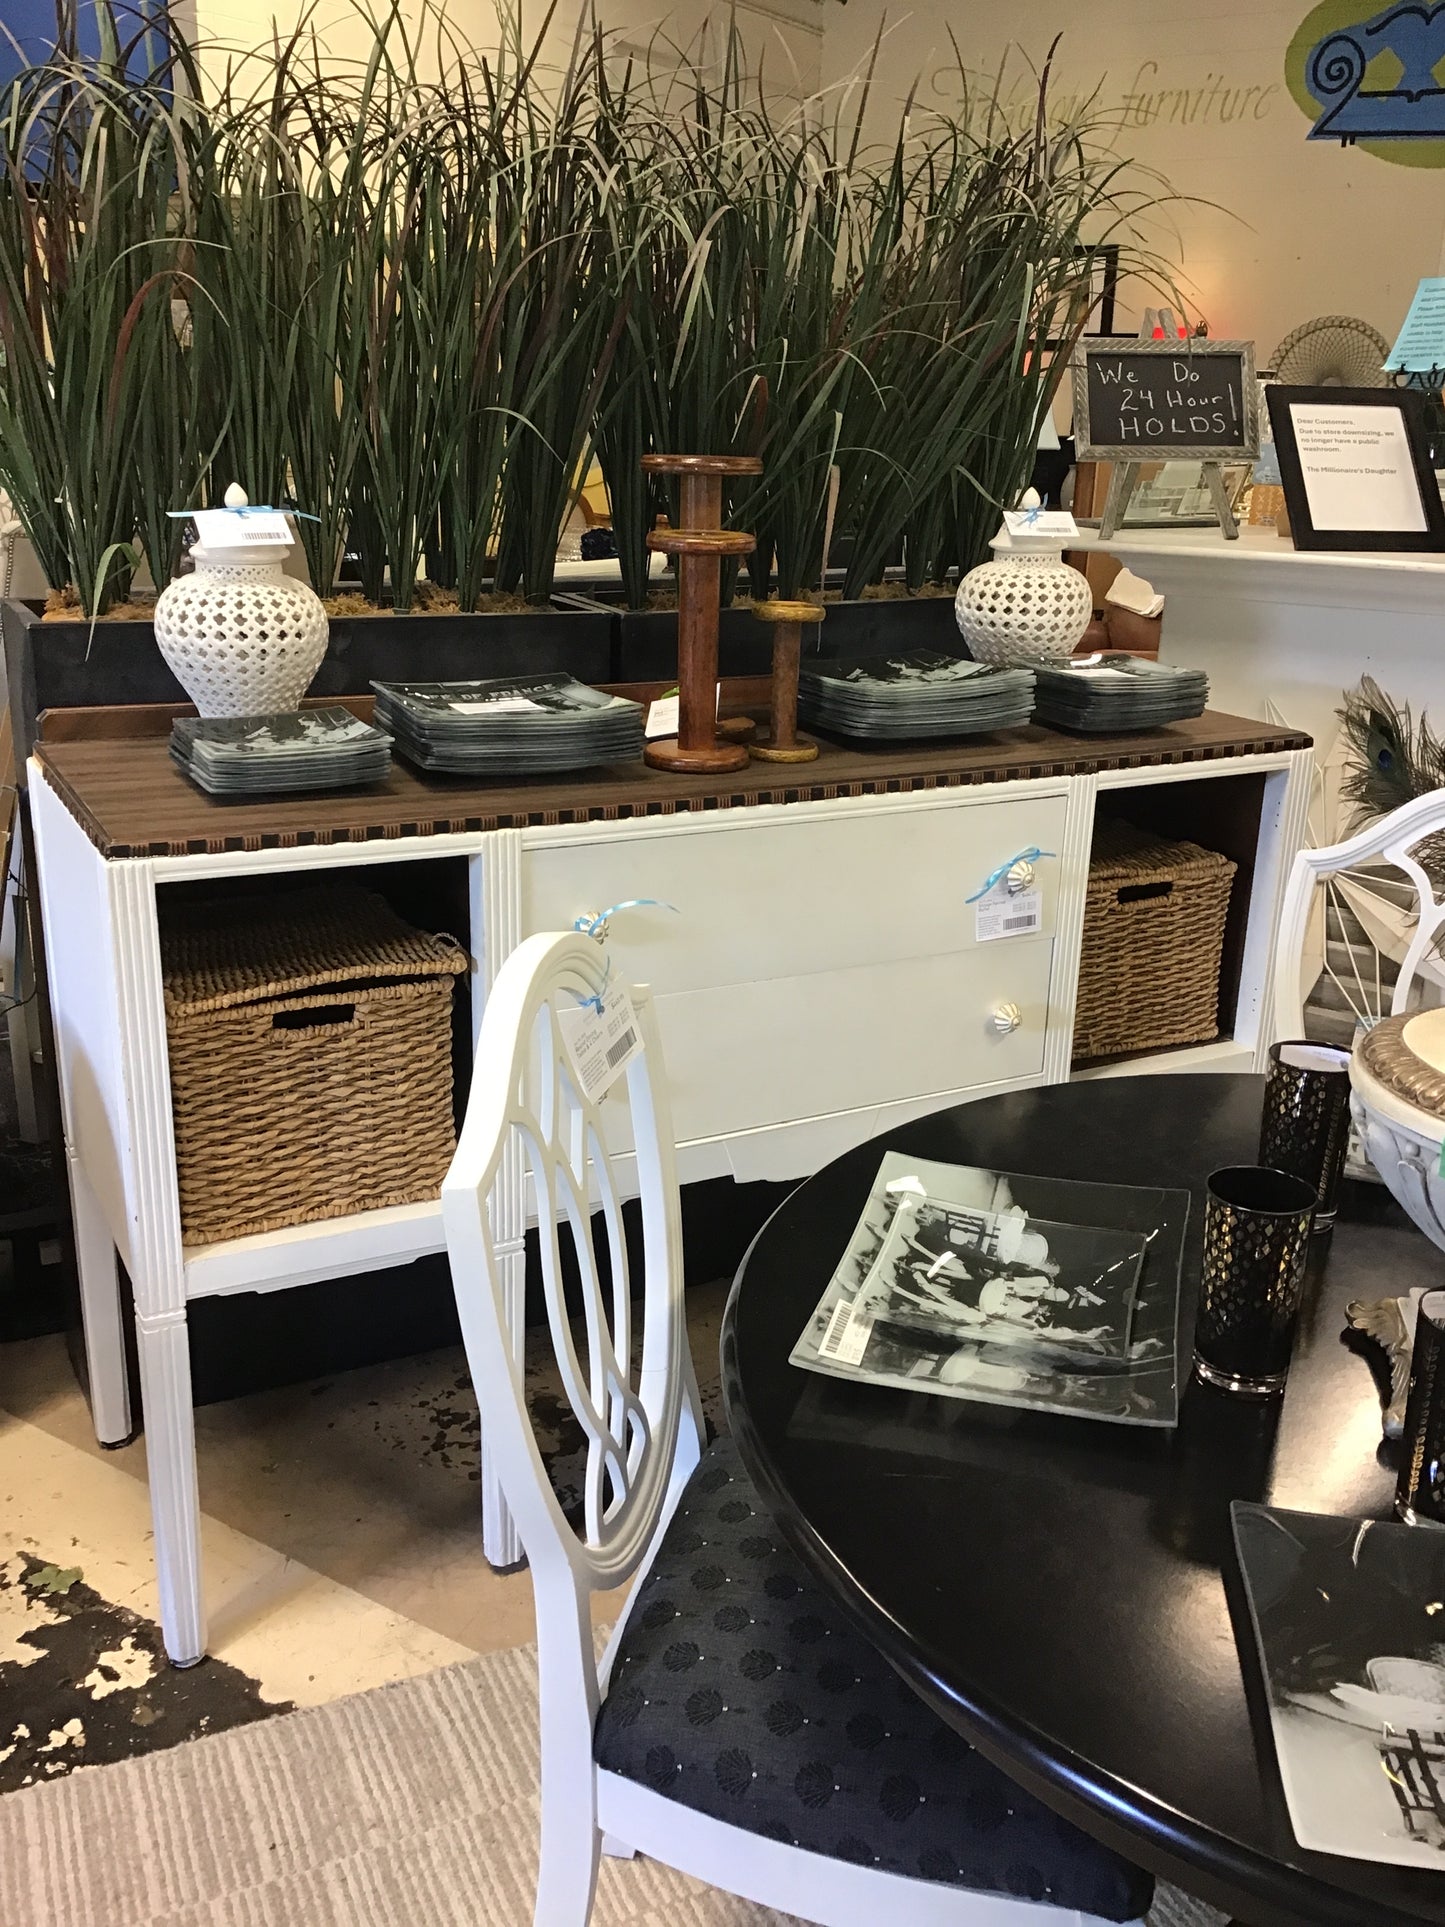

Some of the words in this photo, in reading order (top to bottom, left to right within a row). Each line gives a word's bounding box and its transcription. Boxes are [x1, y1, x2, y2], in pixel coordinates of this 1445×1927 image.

[1102, 61, 1281, 156] furniture
[1096, 362, 1139, 385] We
[1173, 361, 1200, 382] Do
[1120, 388, 1154, 412] 24
[1166, 390, 1223, 408] Hour
[1321, 466, 1364, 474] Millionaire's
